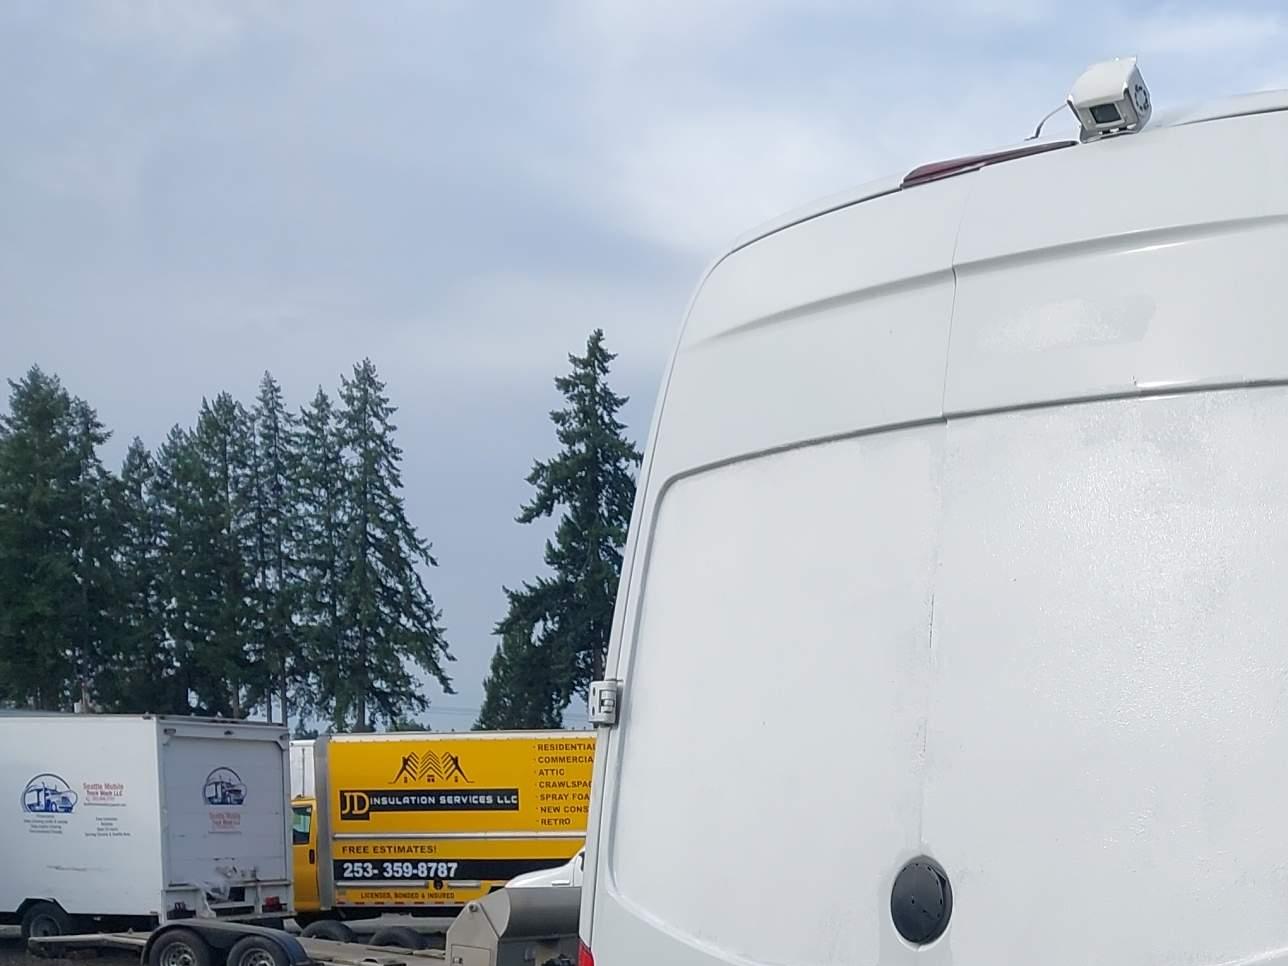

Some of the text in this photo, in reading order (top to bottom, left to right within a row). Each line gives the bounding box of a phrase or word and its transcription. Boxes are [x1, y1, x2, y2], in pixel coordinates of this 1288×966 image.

[538, 768, 565, 776] ATTIC
[540, 793, 569, 801] SPRAY
[341, 791, 518, 815] JD INSULATION SERVICES LLC
[540, 805, 561, 813] NEW
[541, 817, 571, 826] RETRO
[342, 845, 437, 854] FREE ESTIMATES!
[343, 862, 458, 878] 253- 359-8787
